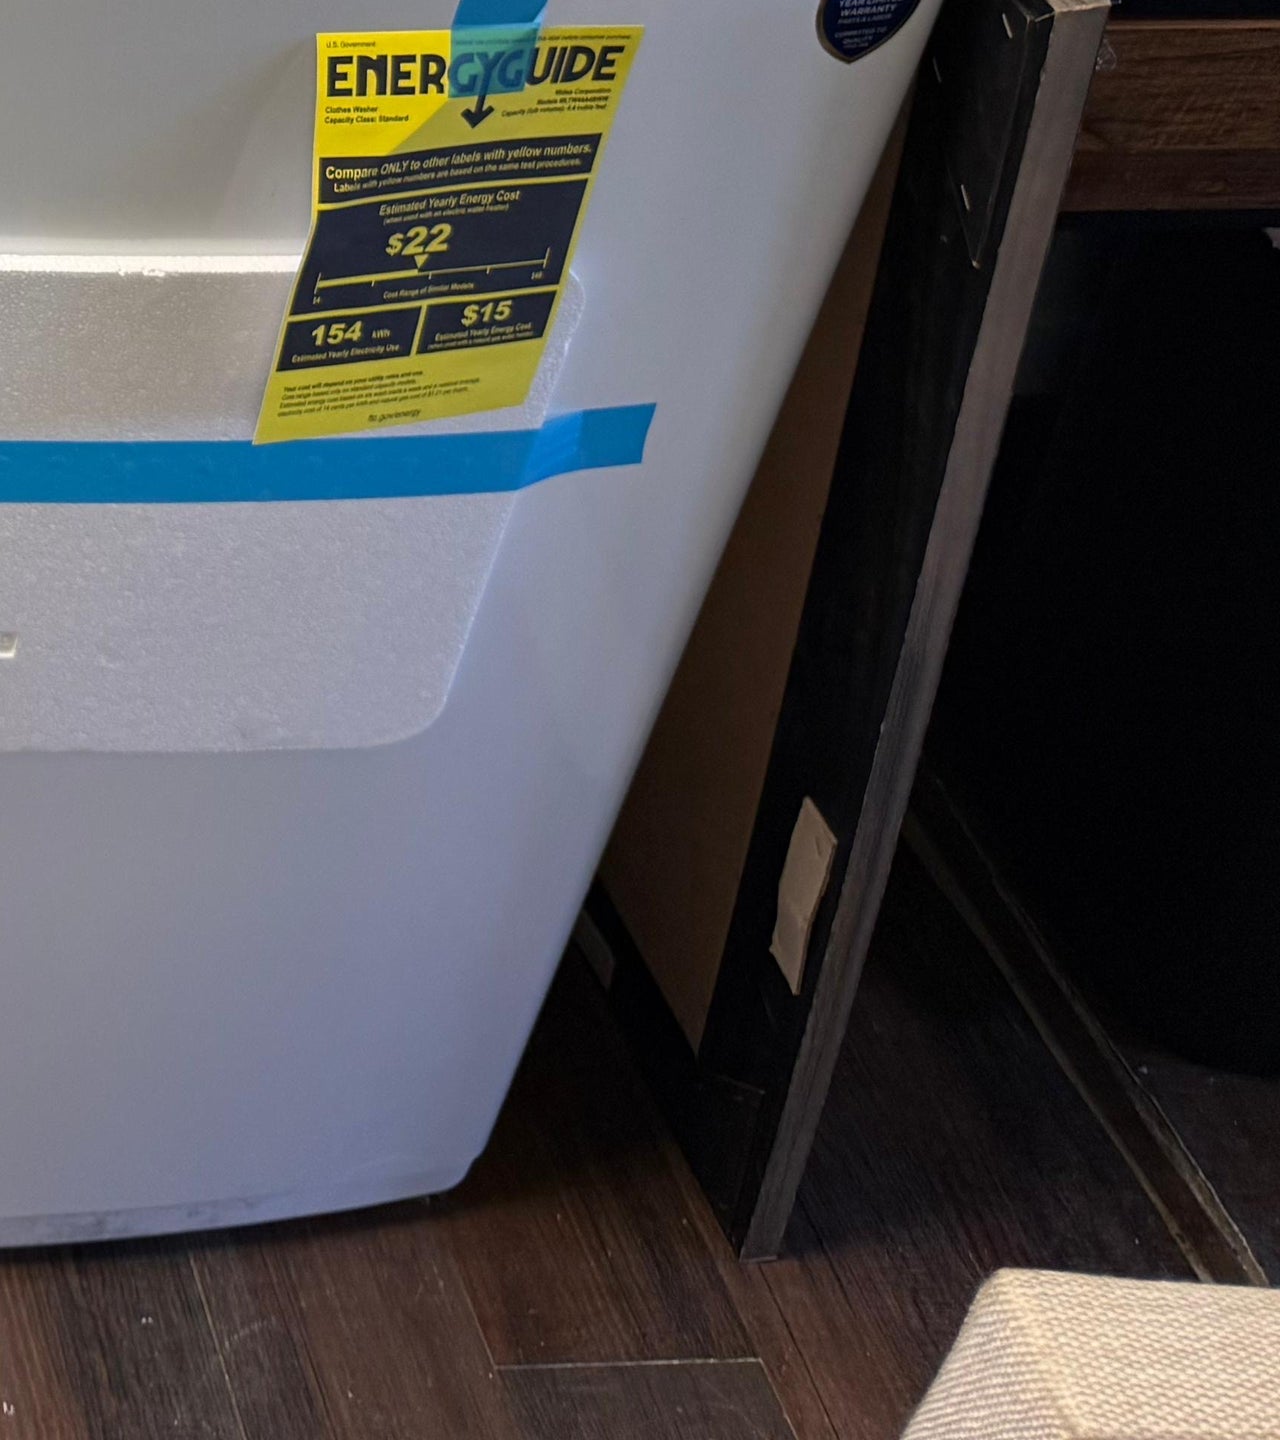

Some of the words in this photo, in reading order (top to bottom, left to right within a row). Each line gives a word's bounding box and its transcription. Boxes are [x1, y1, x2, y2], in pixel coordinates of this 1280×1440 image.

[840, 3, 899, 17] WARRANTY
[324, 115, 354, 125] Capacity
[378, 114, 410, 123] Standard
[325, 105, 352, 114] Clothes
[353, 105, 378, 113] Washer
[325, 166, 379, 181] Compare
[380, 160, 410, 175] ONLY
[410, 160, 422, 170] to
[422, 155, 450, 169] other
[451, 150, 481, 165] labels
[483, 147, 505, 161] with
[507, 145, 541, 160] yellow
[543, 143, 592, 156] numbers.
[333, 181, 360, 193] Labels
[379, 199, 427, 217] Estimated
[428, 195, 458, 209] Yearly
[459, 191, 494, 205] Energy
[496, 190, 521, 202] Cost
[385, 222, 453, 257] $22
[460, 299, 513, 327] $15
[311, 320, 363, 347] 154
[291, 351, 327, 364] Estimated
[328, 348, 350, 360] Yearly
[350, 344, 385, 357] Electricity
[385, 343, 400, 352] Use
